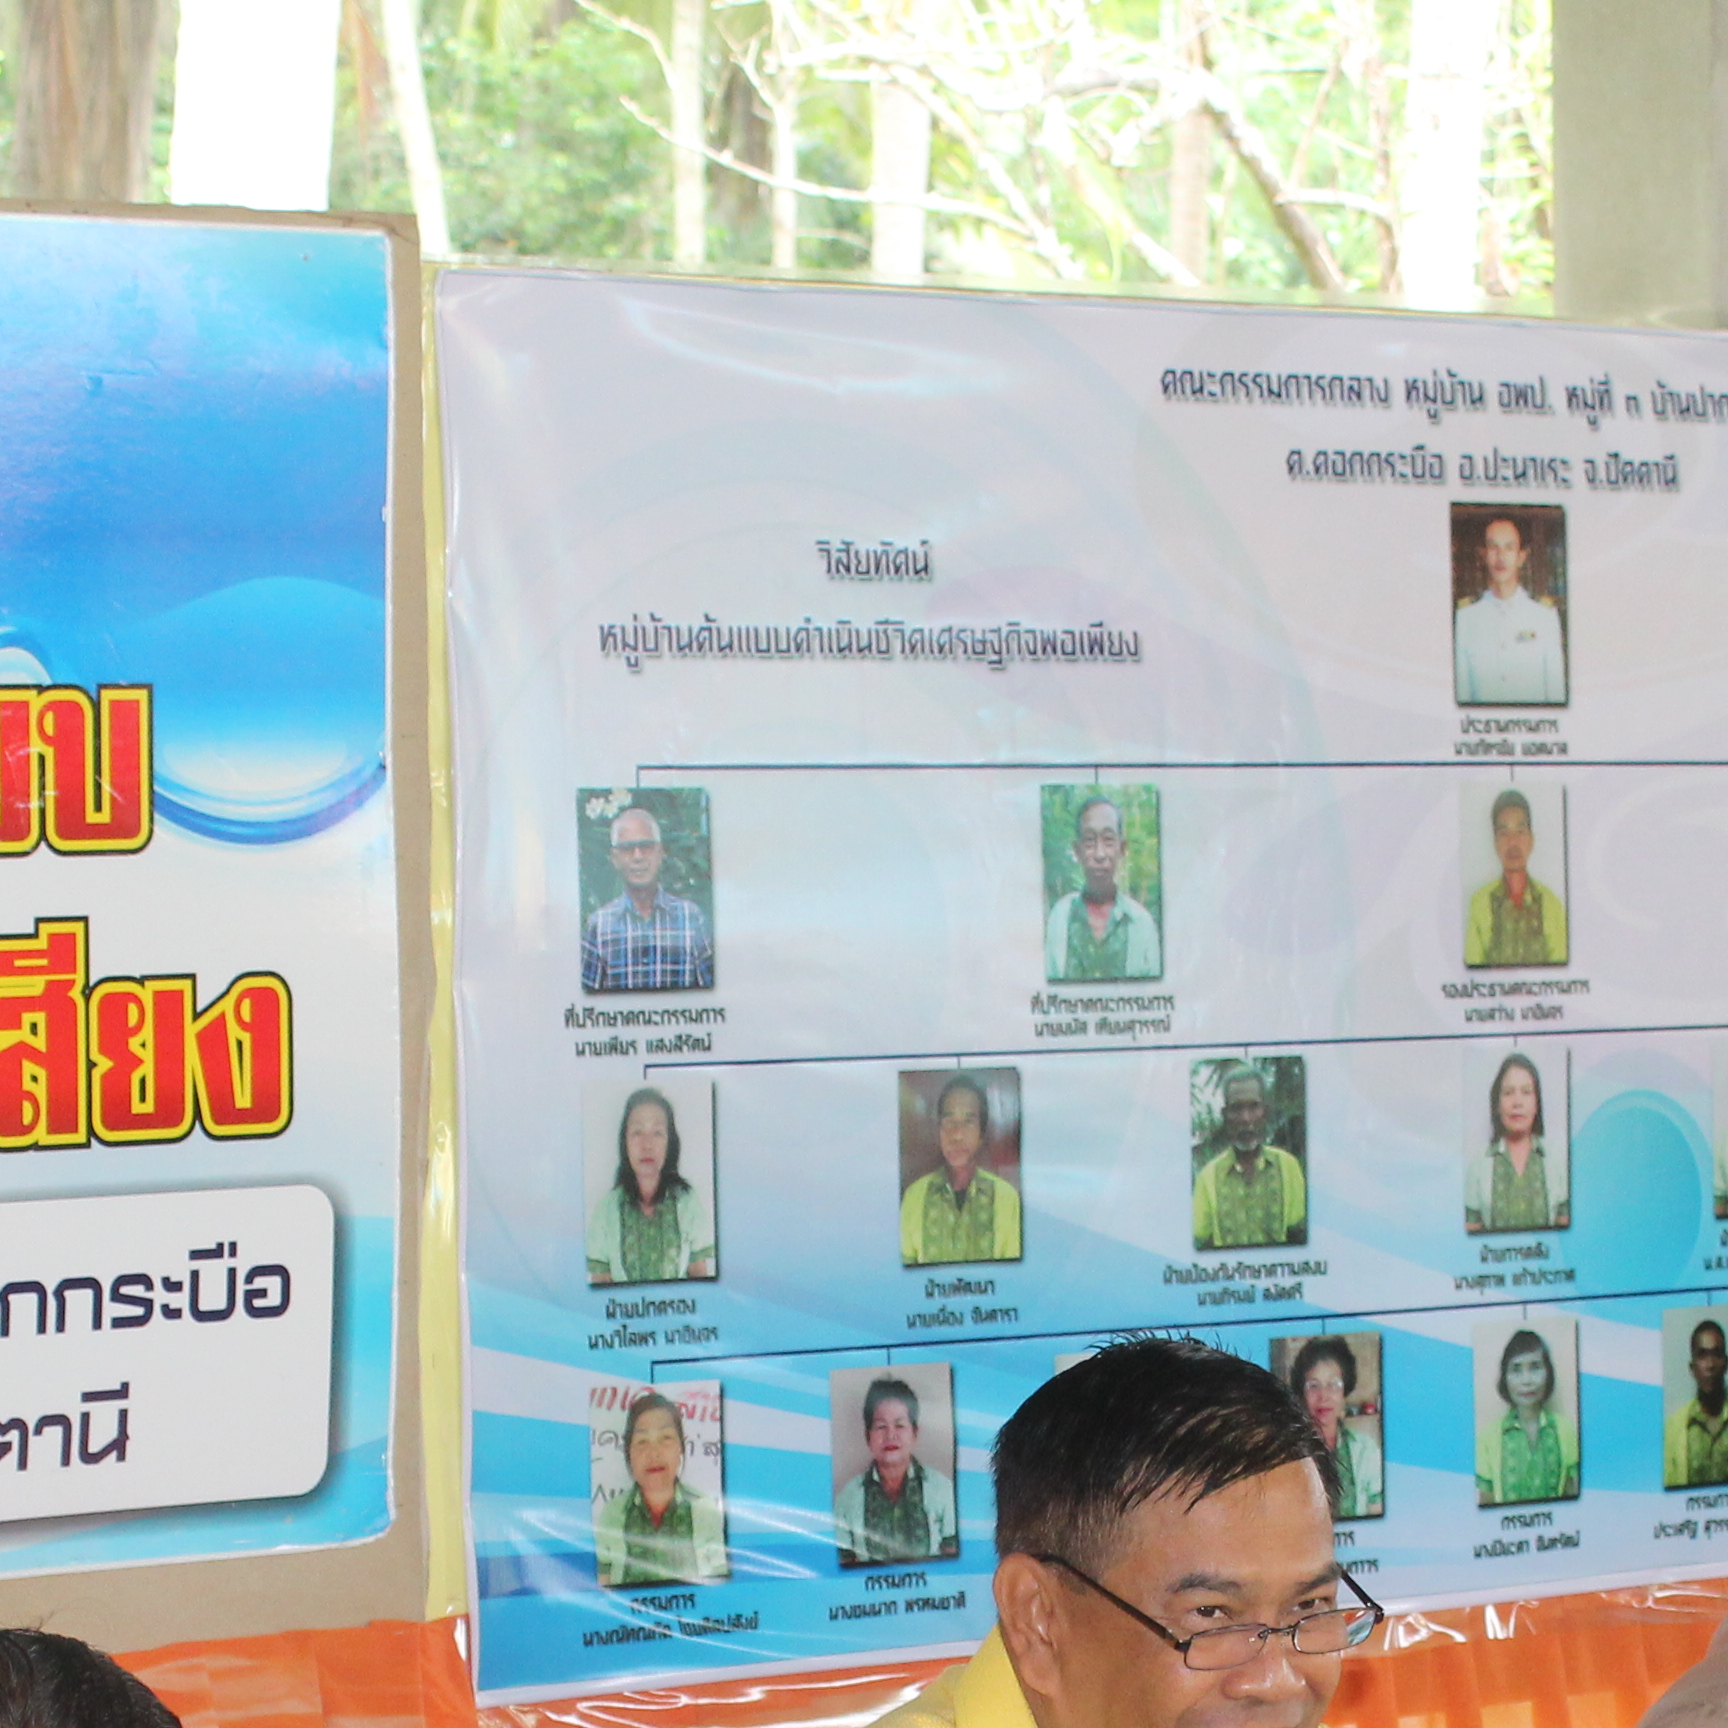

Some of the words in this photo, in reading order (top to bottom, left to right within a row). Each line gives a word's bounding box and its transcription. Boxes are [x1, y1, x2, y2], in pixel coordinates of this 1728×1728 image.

[1160, 368, 1389, 407] คณะกรรมการกลาง
[1405, 370, 1484, 424] หมู่บ้าน
[1566, 376, 1610, 430] หมู่ที่
[1287, 445, 1444, 482] ต.คอกกระบือ
[1459, 447, 1571, 485] อ.ปะนาเระ
[1584, 452, 1680, 490] จ.ปัตตานี
[817, 538, 933, 580] วิสัยทัศน์
[599, 613, 1142, 671] หมู่บ้านต้นแบบดำเนินชีวิตเศรษฐกิจพอเพียง
[564, 1003, 727, 1029] ที่ปรึกษาคณะกรรมการ
[1031, 990, 1175, 1015] ที่ปรึกษาคณะกรรมการ
[1501, 1511, 1555, 1531] กรรมการ
[864, 1570, 928, 1592] กรรมการ
